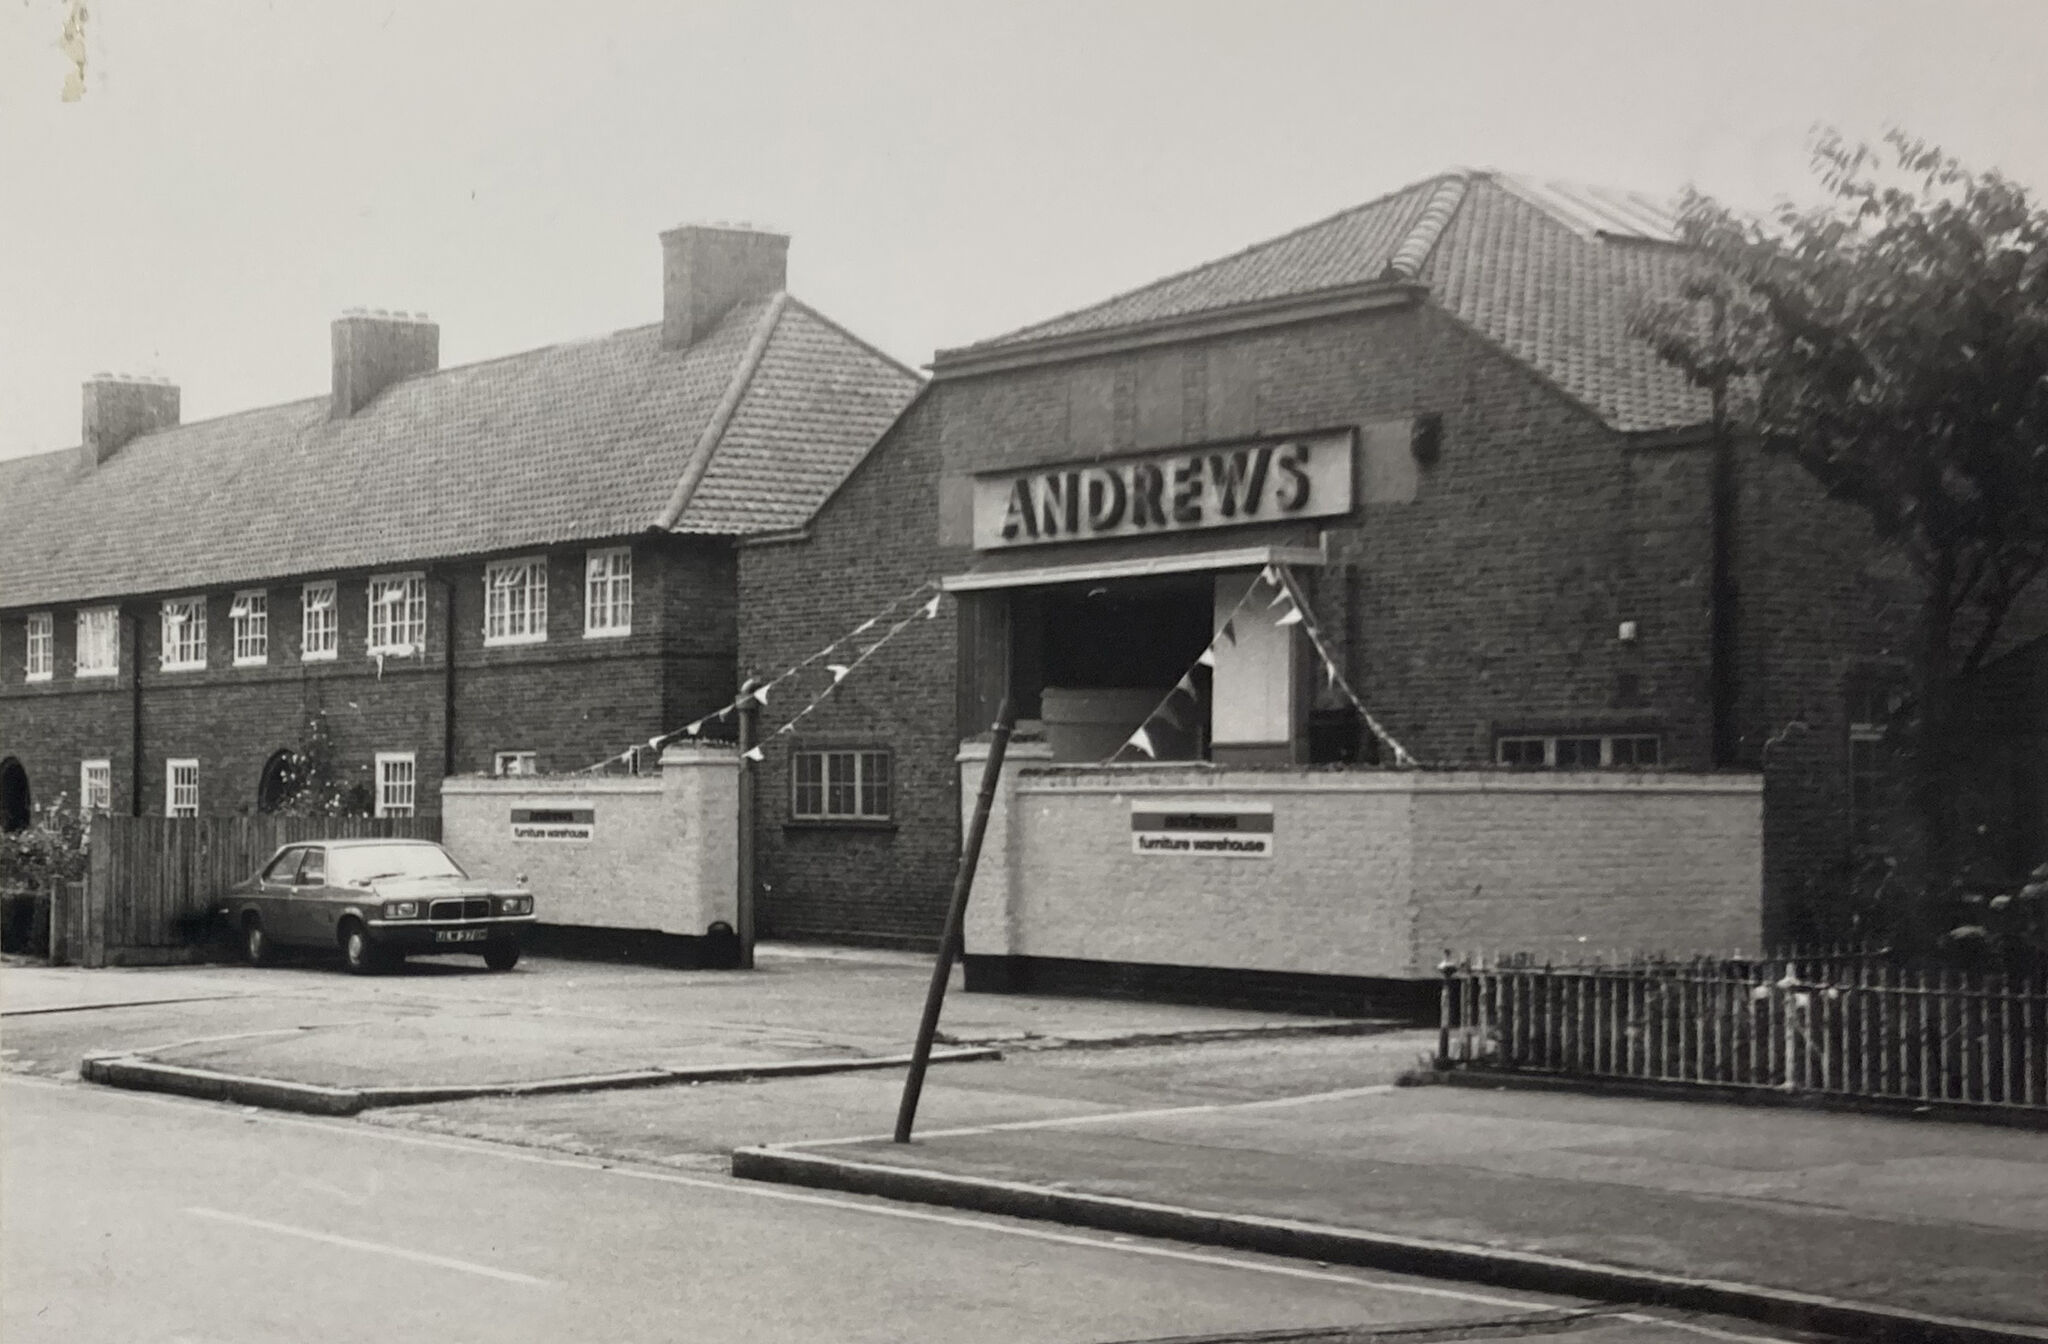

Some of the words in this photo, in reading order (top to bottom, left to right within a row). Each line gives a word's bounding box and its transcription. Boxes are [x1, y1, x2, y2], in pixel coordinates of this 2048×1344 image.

[1000, 444, 1311, 539] ANDREWS
[514, 827, 545, 838] furniture
[547, 828, 589, 839] warehouse
[1139, 835, 1190, 850] furniture
[1193, 837, 1265, 852] warehouse
